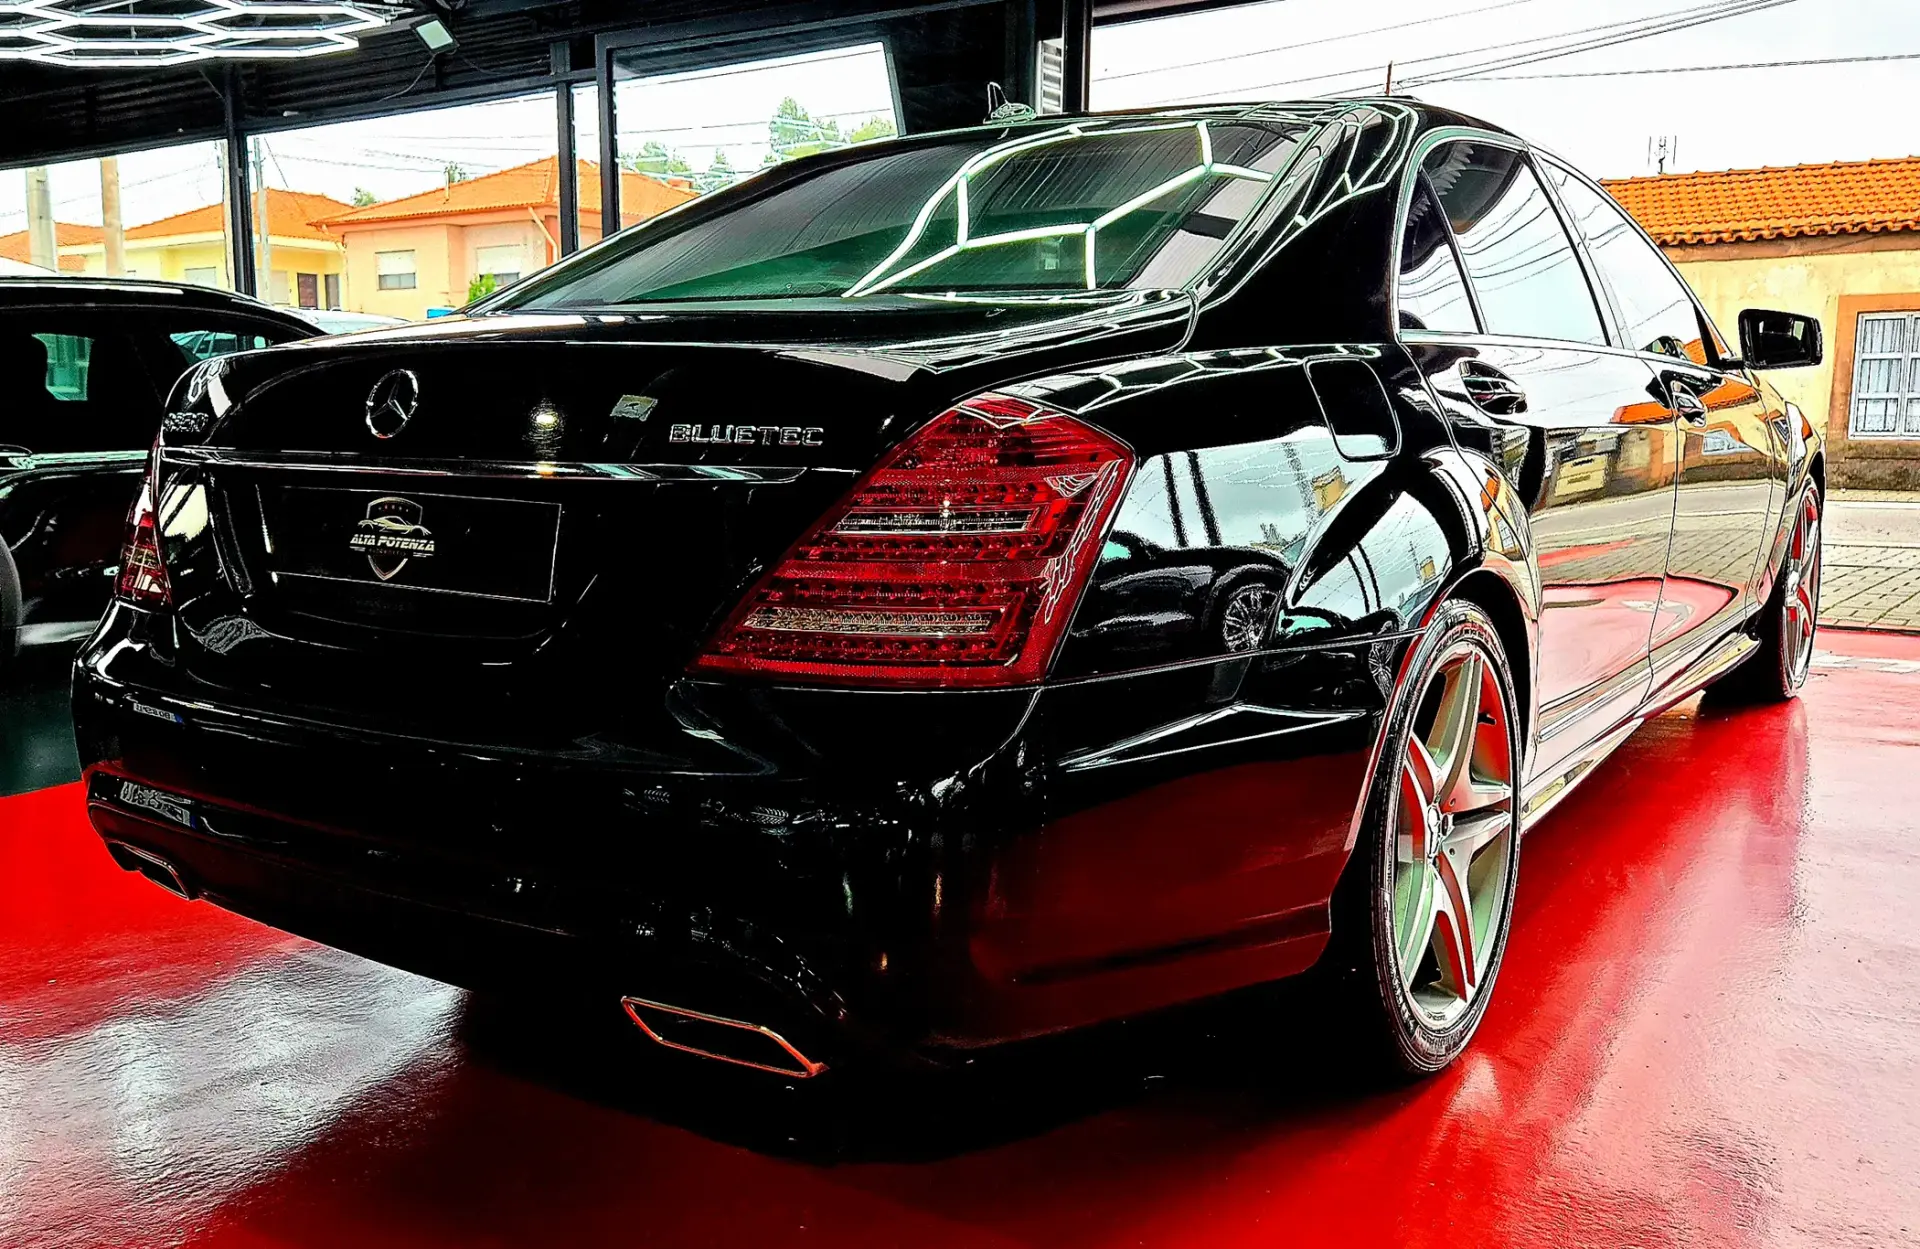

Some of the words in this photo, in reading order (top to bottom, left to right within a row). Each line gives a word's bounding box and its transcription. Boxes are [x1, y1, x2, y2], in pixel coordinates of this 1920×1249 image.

[669, 423, 824, 446] BLUETEC
[350, 534, 375, 546] ALTA
[377, 536, 434, 551] POTENZA
